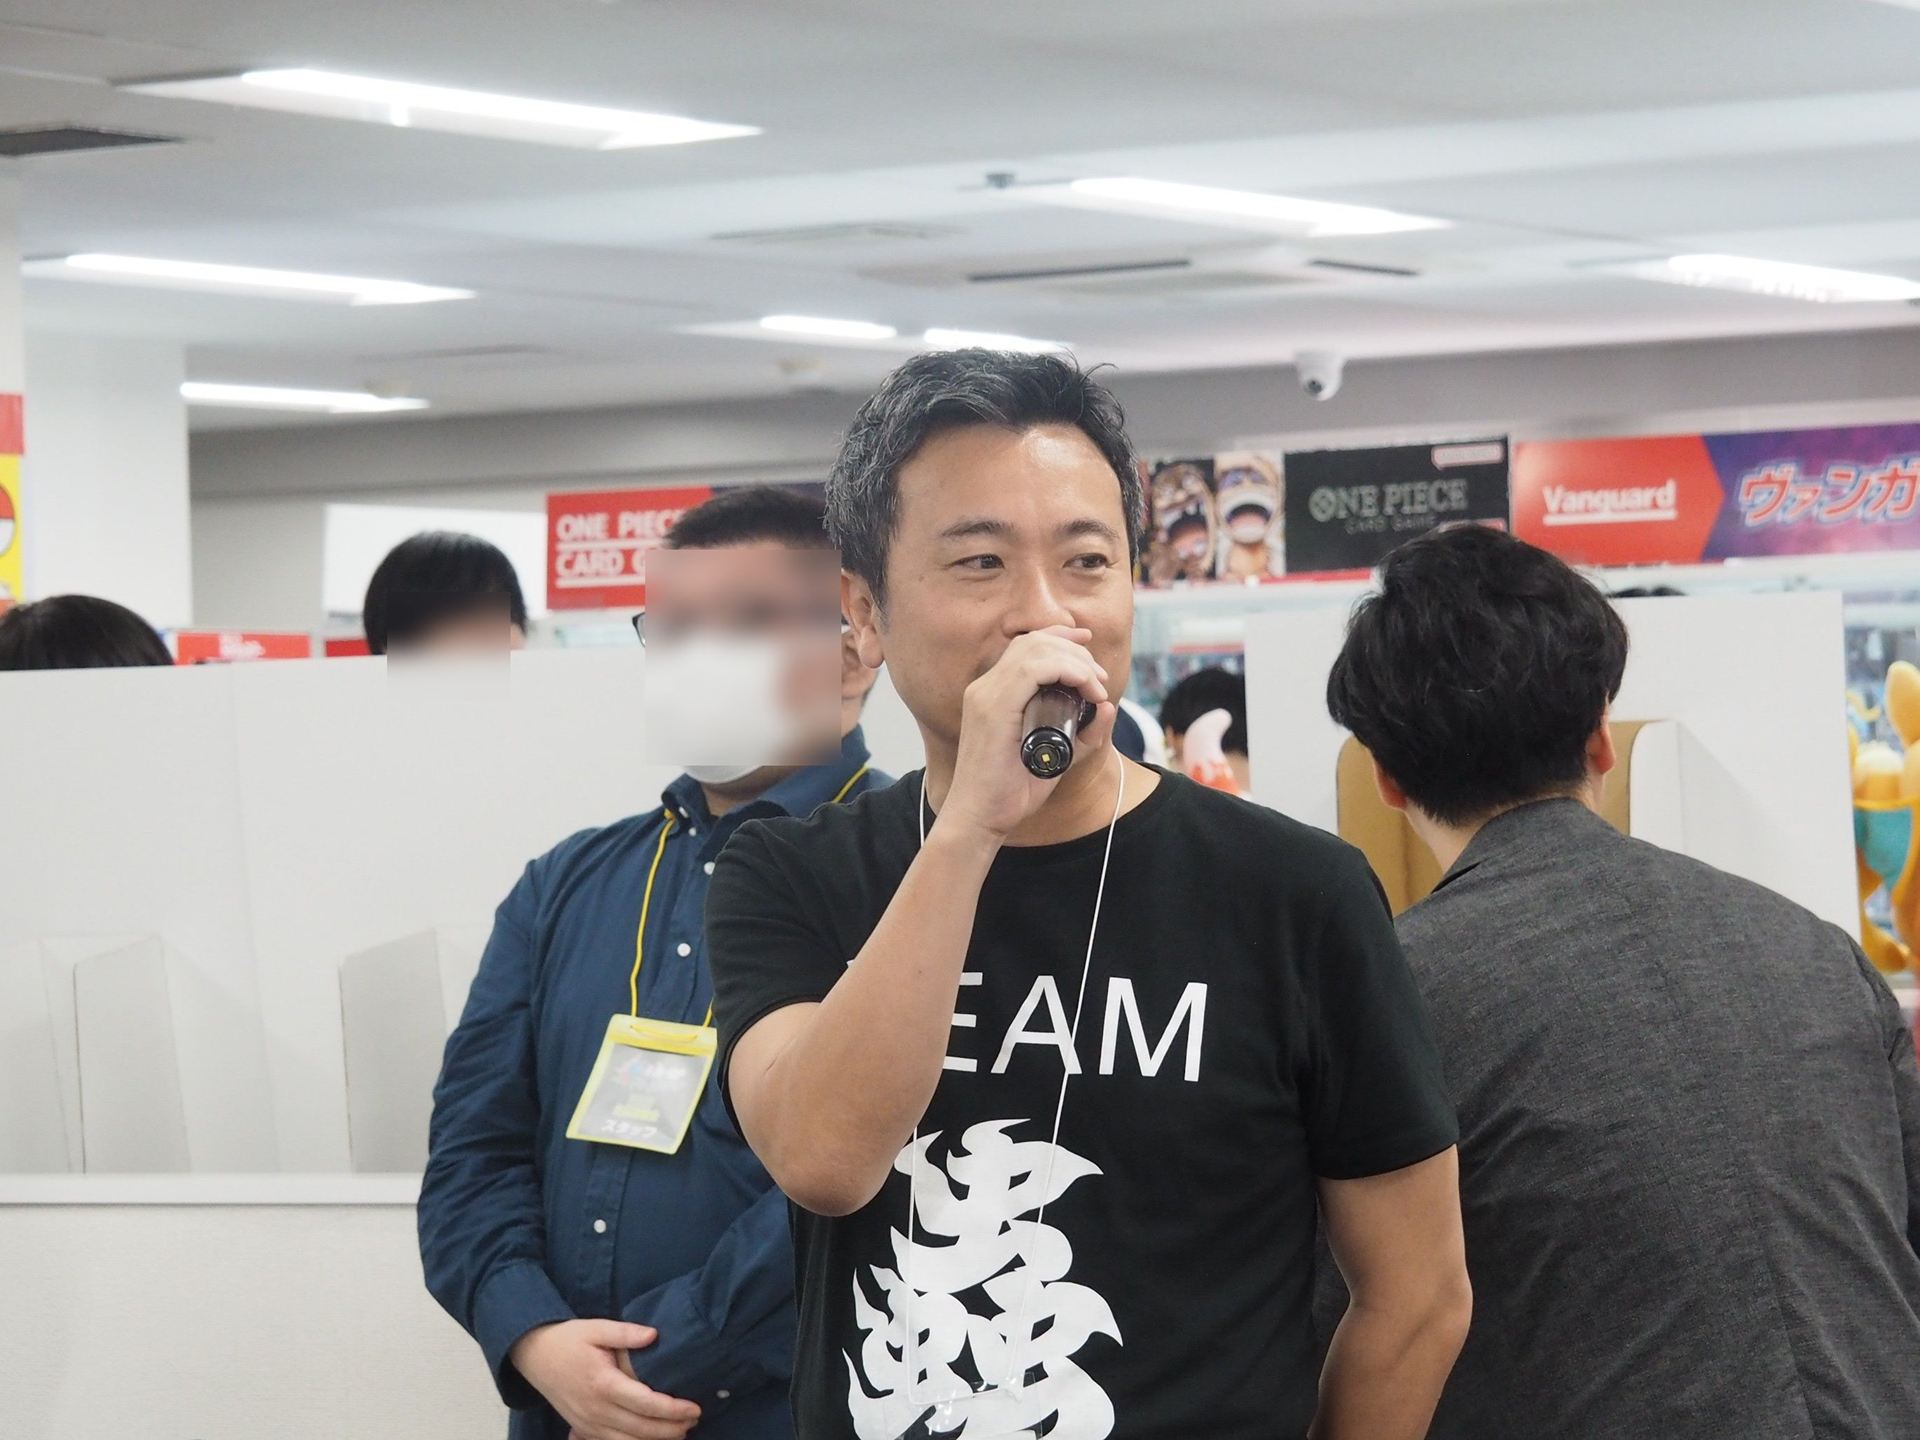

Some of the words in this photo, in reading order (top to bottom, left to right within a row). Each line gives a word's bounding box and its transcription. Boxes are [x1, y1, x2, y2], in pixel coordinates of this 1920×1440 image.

[1308, 484, 1379, 522] ONE
[1382, 478, 1467, 515] PIECE
[1543, 479, 1677, 514] Vanguard
[556, 513, 609, 541] ONE
[618, 509, 685, 539] PIEC
[556, 550, 624, 577] CARD
[846, 959, 1207, 1083] EAM
